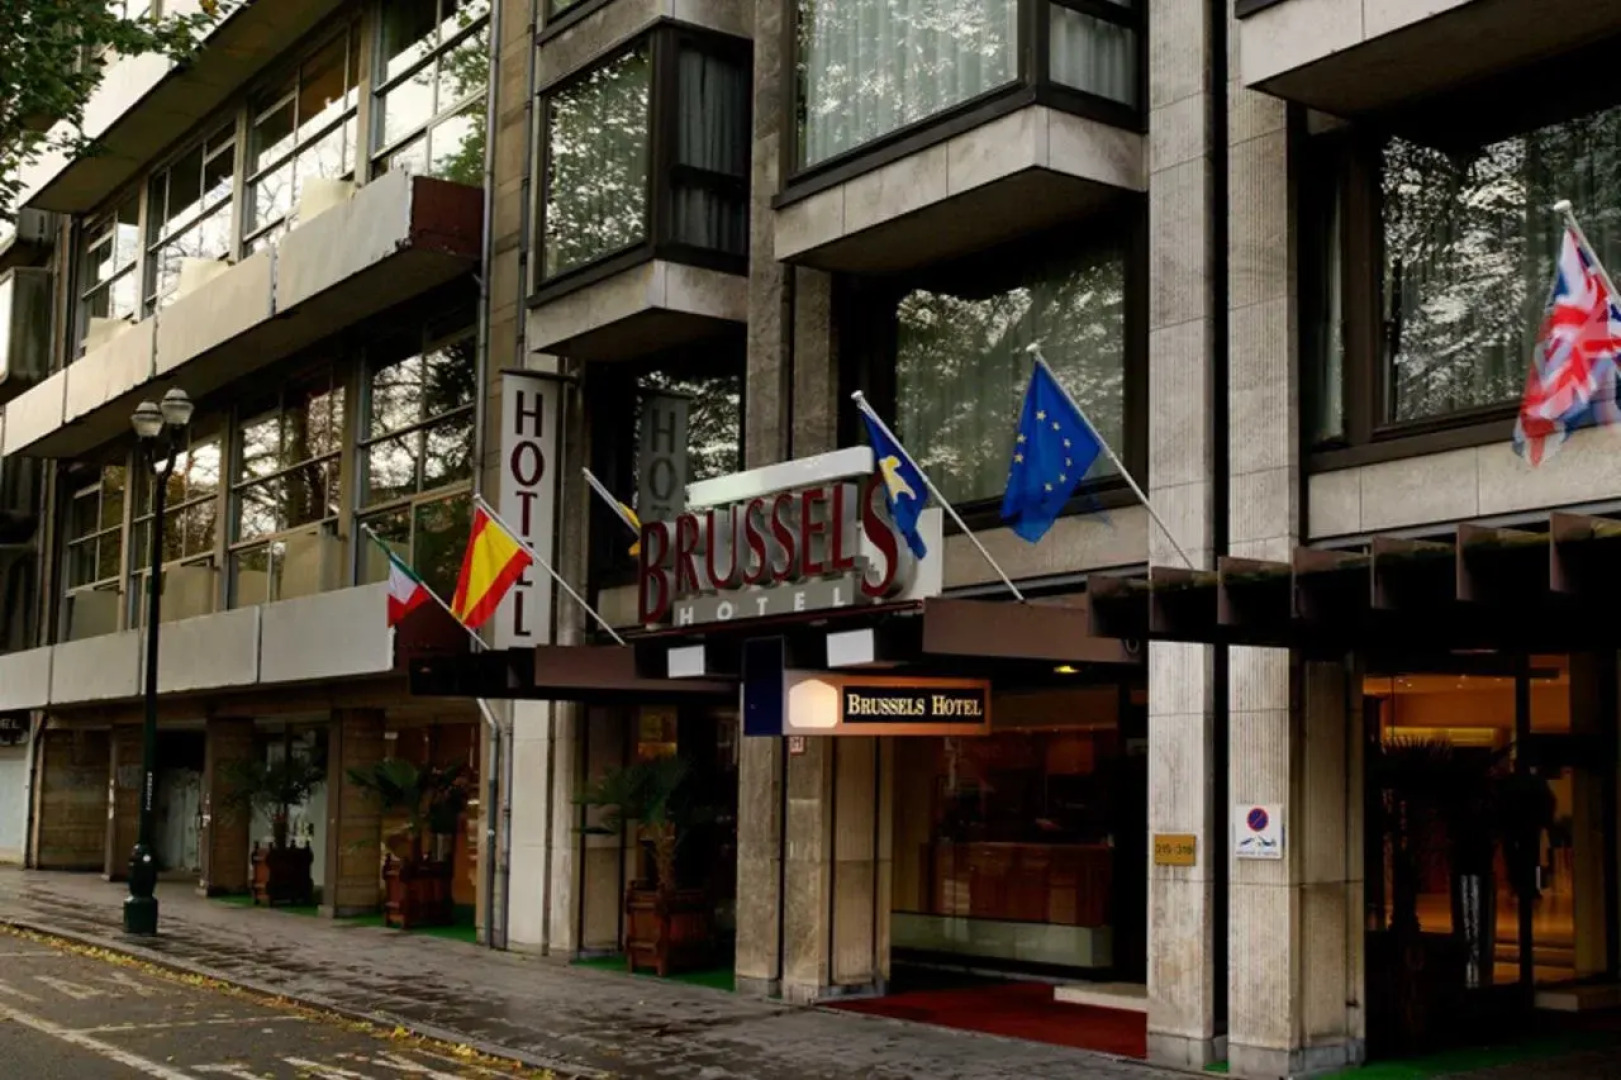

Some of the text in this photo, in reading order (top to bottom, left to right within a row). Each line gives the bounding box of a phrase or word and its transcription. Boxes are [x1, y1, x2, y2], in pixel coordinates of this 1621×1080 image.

[638, 469, 899, 625] BRUSSELS
[679, 585, 847, 627] HOTEL
[847, 693, 982, 716] BRUSSELS HOTEL
